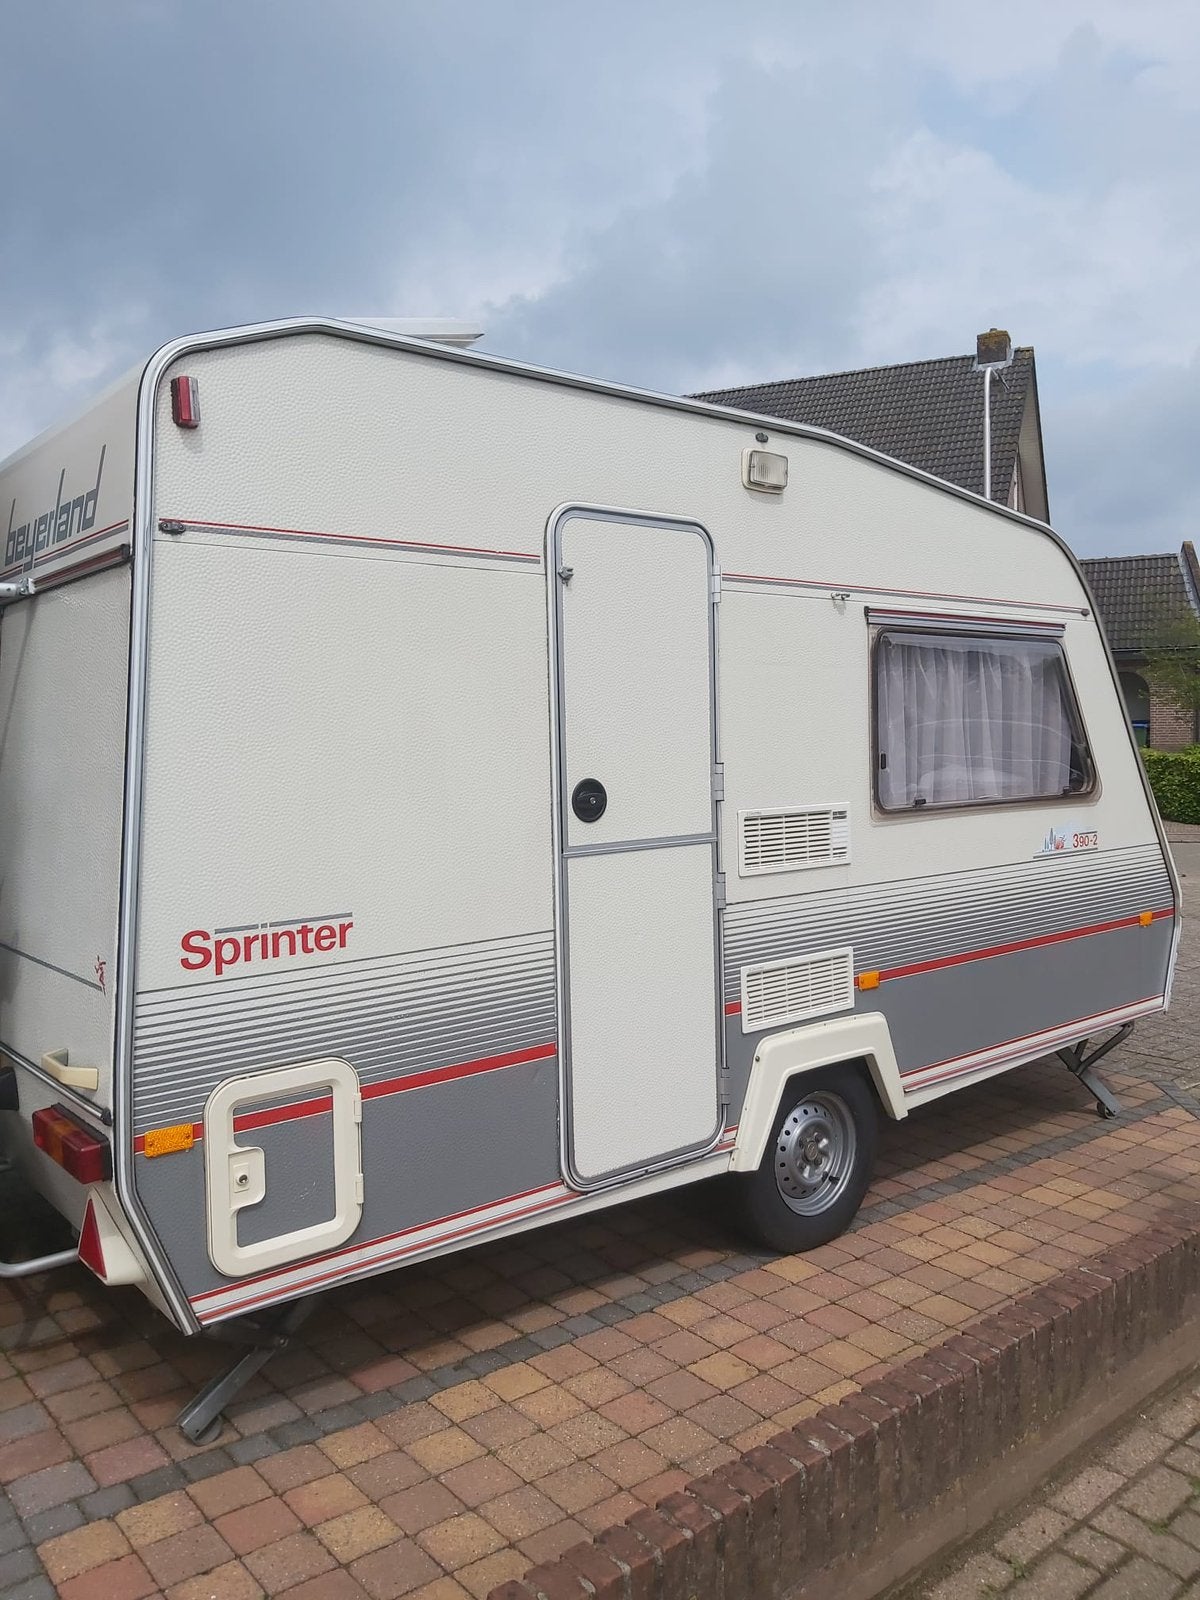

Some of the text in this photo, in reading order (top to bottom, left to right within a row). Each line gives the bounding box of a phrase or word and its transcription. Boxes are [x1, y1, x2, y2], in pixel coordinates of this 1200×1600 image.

[5, 444, 106, 572] beyerland
[1072, 833, 1098, 848] 390-2
[180, 921, 354, 976] Sprinter
